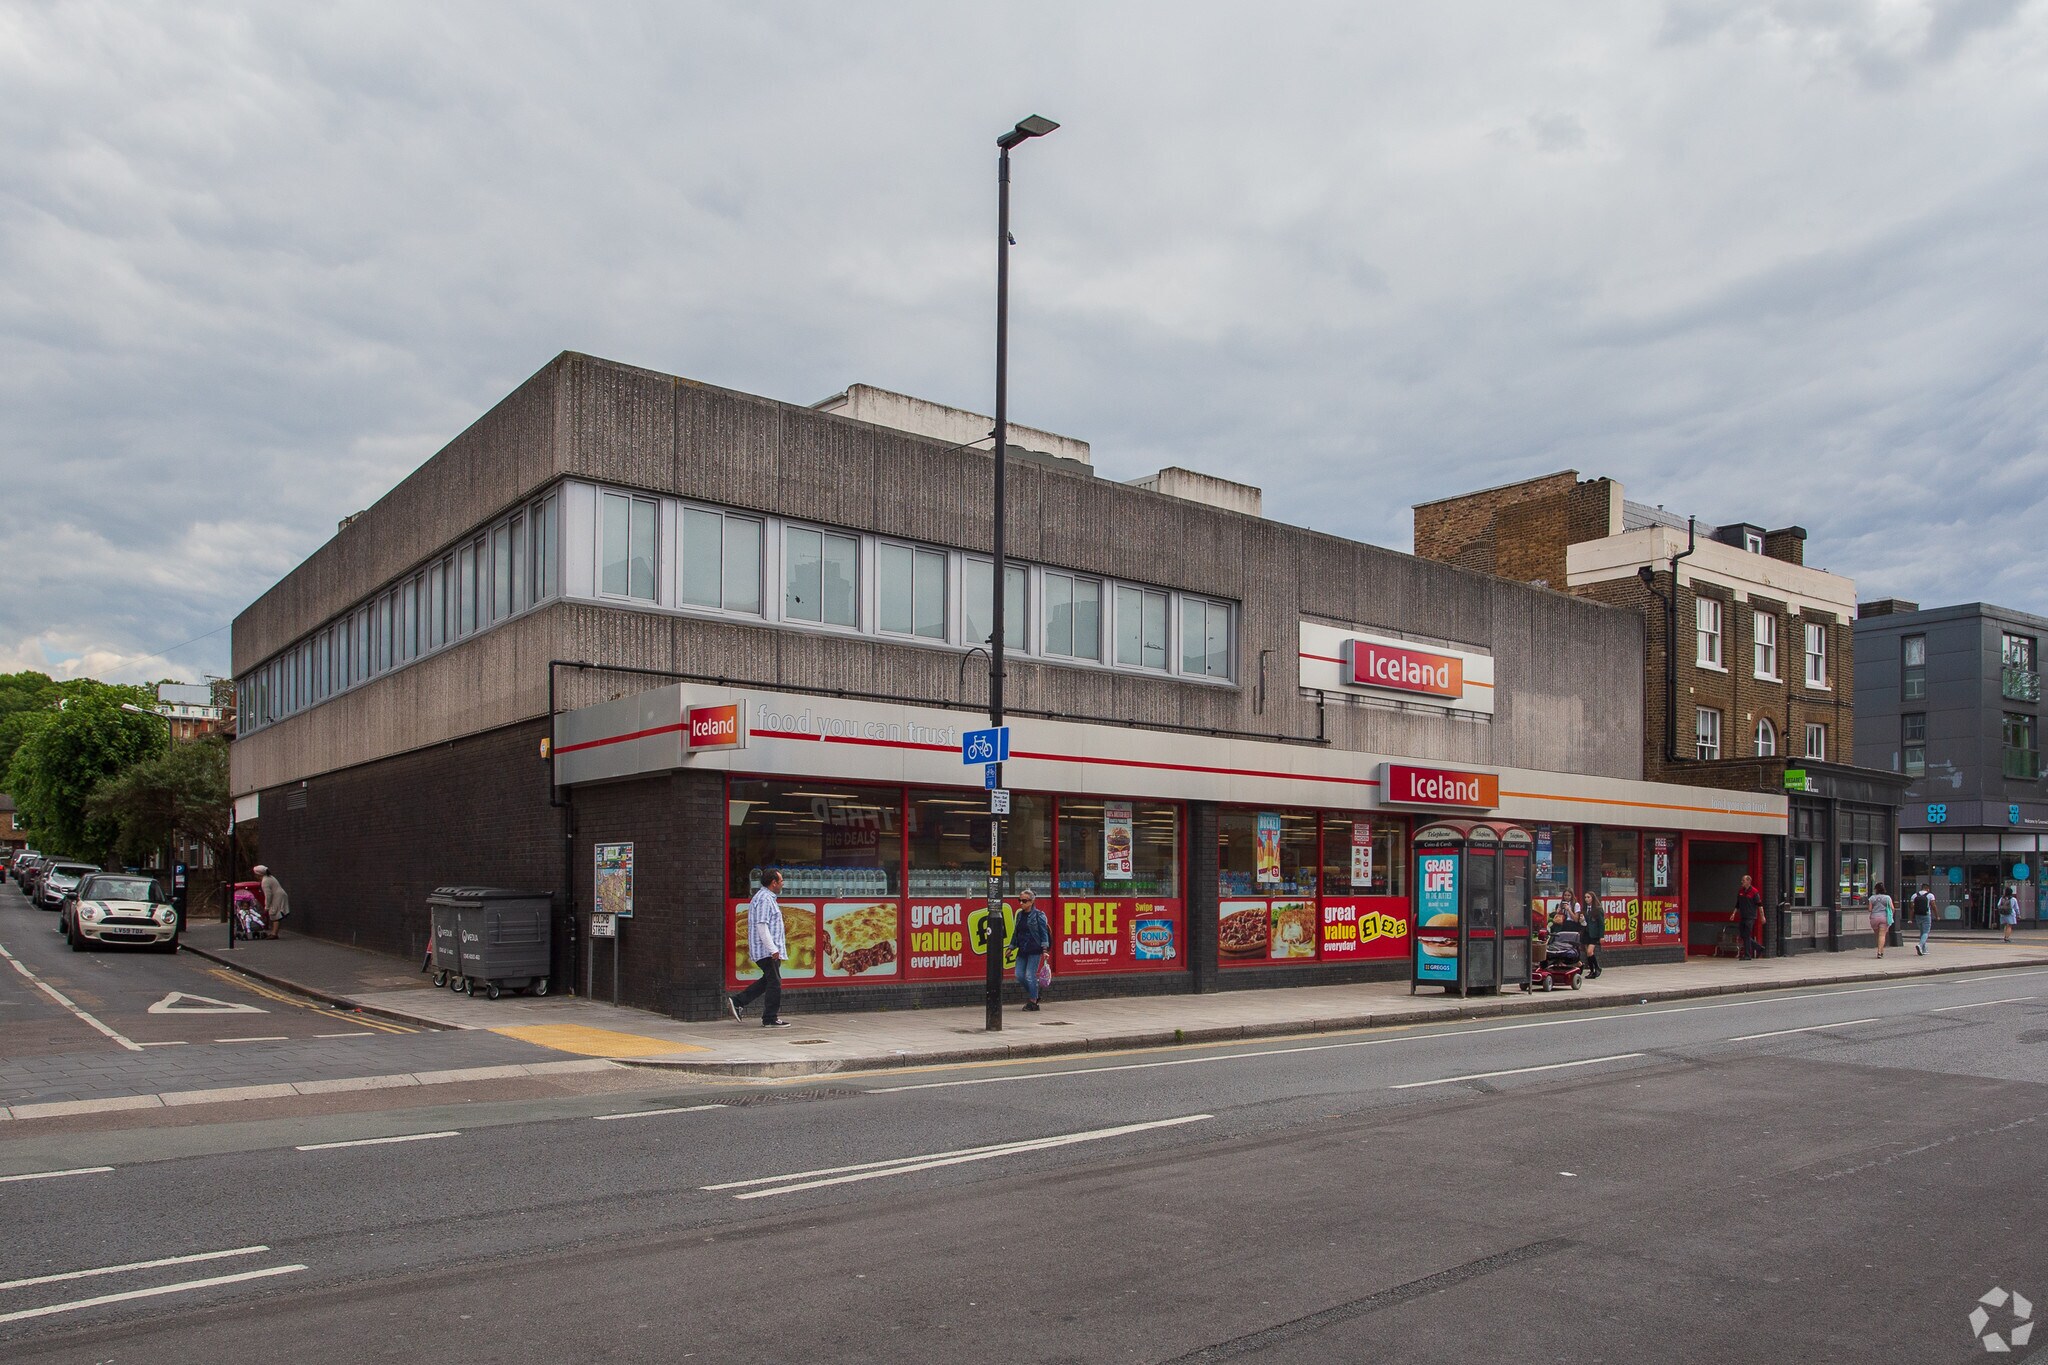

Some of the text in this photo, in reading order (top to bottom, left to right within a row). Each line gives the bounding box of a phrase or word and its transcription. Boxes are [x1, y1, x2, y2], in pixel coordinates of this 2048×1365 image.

[1369, 649, 1449, 689] Iceland
[693, 716, 735, 737] Iceland
[757, 704, 955, 746] food you can trust
[1410, 772, 1479, 802] Iceland
[826, 830, 876, 847] BIG DEALS
[1538, 831, 1551, 840] FREE
[1655, 838, 1667, 847] FREE
[1121, 862, 1130, 870] £2
[1425, 859, 1454, 872] GRAB
[1424, 873, 1454, 892] LIFE
[1135, 903, 1153, 912] Swipe
[1324, 905, 1356, 923] great
[1628, 902, 1637, 916] £1
[593, 914, 610, 924] COLOMB
[911, 903, 962, 929] great
[1604, 915, 1627, 931] alue
[592, 925, 609, 935] STREET
[1324, 923, 1357, 939] value
[1362, 917, 1378, 938] £1
[1381, 919, 1394, 935] £2
[1396, 922, 1406, 935] £3
[910, 928, 963, 952] value
[1141, 931, 1169, 941] BONUS
[1604, 932, 1627, 943] eryday!
[1063, 937, 1118, 957] delivery
[1324, 941, 1356, 952] everyday!
[910, 953, 963, 969] everyday!
